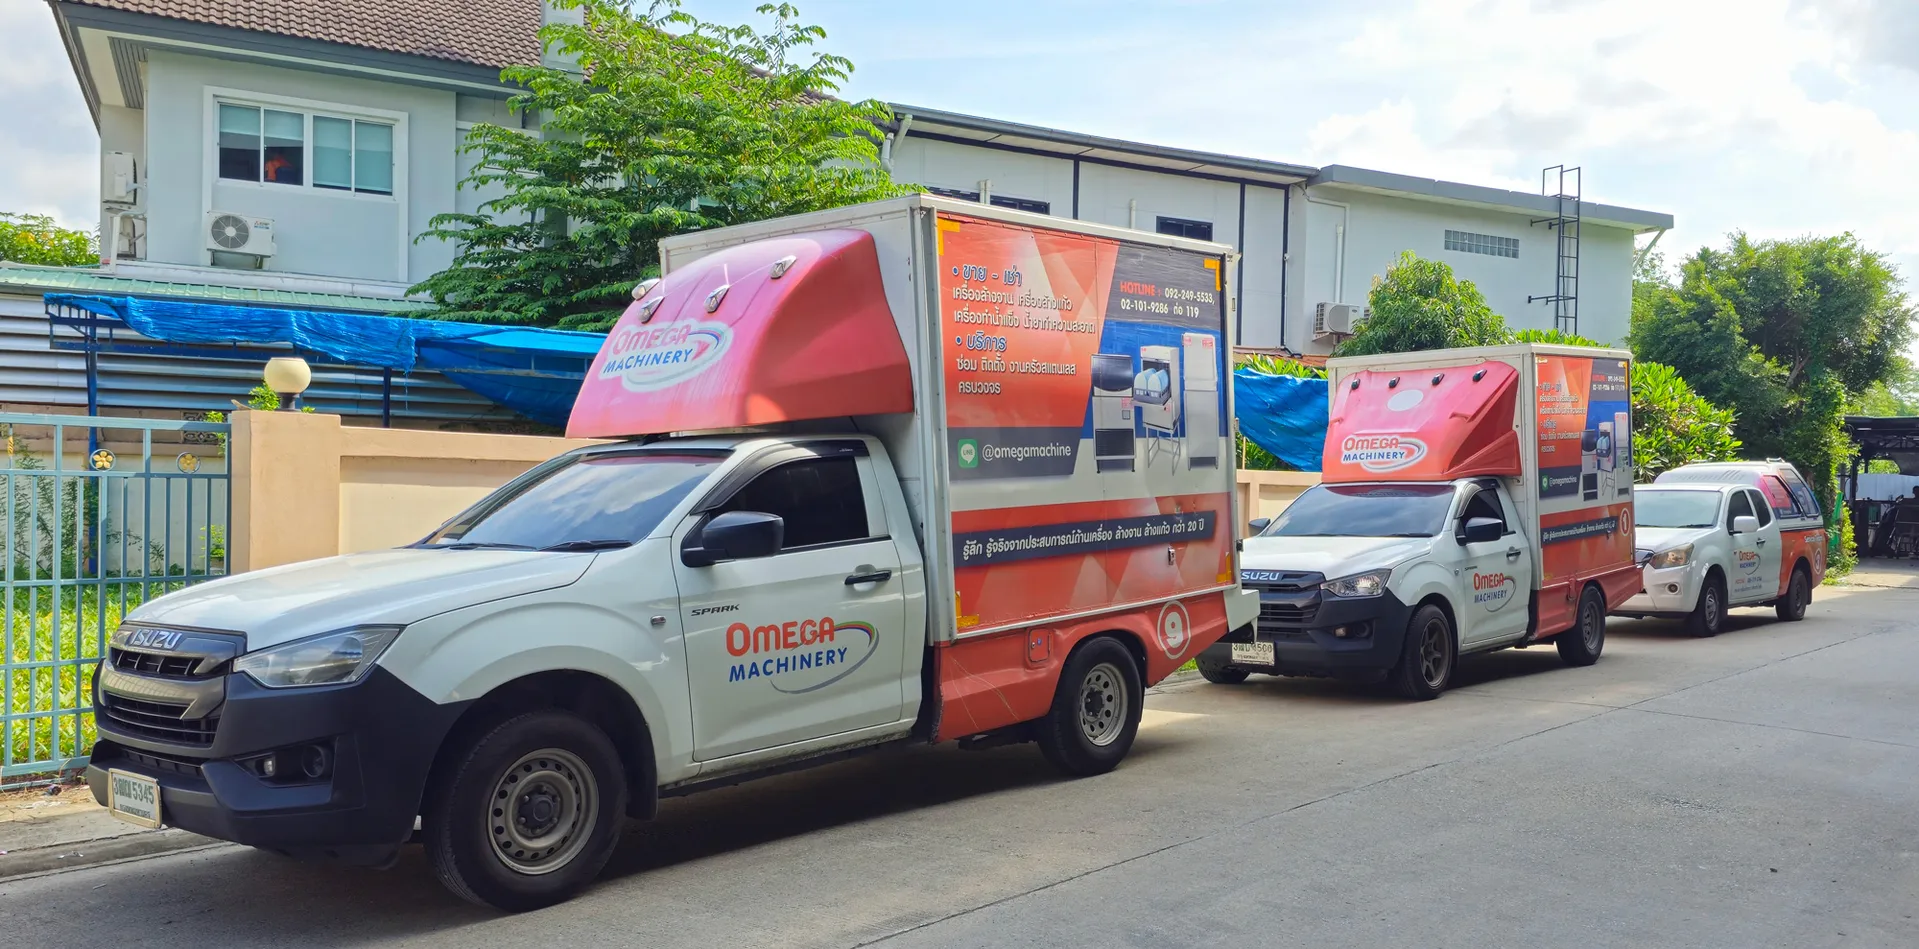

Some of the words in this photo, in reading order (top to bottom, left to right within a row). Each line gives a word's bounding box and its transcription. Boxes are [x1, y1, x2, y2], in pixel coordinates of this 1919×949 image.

[962, 264, 987, 282] ขาย
[1003, 265, 1023, 287] เช่า
[953, 281, 1014, 306] เครื่องล้างจาน
[1018, 289, 1073, 312] เครื่องล้างแก้ว
[1120, 281, 1156, 296] HOTLINE
[1164, 287, 1215, 306] 092-249-5533,
[954, 303, 1020, 328] เครื่องทำน้ำแข็ง
[1120, 298, 1169, 315] 02-101-9286
[1173, 302, 1183, 316] ต่อ
[1186, 305, 1200, 319] 119
[612, 323, 692, 356] OMEGA
[966, 331, 1007, 352] บริการ
[603, 348, 694, 375] MACHINERY
[956, 354, 978, 372] ซ่อม
[981, 353, 1006, 372] ติดตั้ง
[1009, 359, 1076, 375] งานครัวสแตนเลส
[958, 381, 1001, 395] ครบวงจร
[962, 448, 974, 456] LINE
[982, 442, 1072, 462] @omegamachine
[1343, 437, 1399, 451] OMEGA
[1342, 451, 1405, 462] MACHINERY
[963, 540, 983, 561] รู้ลึก
[1115, 525, 1142, 540] ล้างจาน
[1144, 521, 1170, 537] ล้างแก้ว
[1172, 518, 1185, 533] กว่า
[1187, 521, 1197, 533] 20
[1198, 517, 1205, 531] ปี
[1241, 572, 1280, 581] SUZU
[1473, 572, 1505, 591] OMEGA
[1474, 590, 1508, 604] MACHINERY
[690, 604, 740, 617] SPARK
[130, 628, 183, 649] ISUZU
[726, 616, 836, 657] OMEGA
[1164, 610, 1183, 650] 9
[729, 647, 848, 683] MACHINERY
[132, 781, 155, 805] 5345
